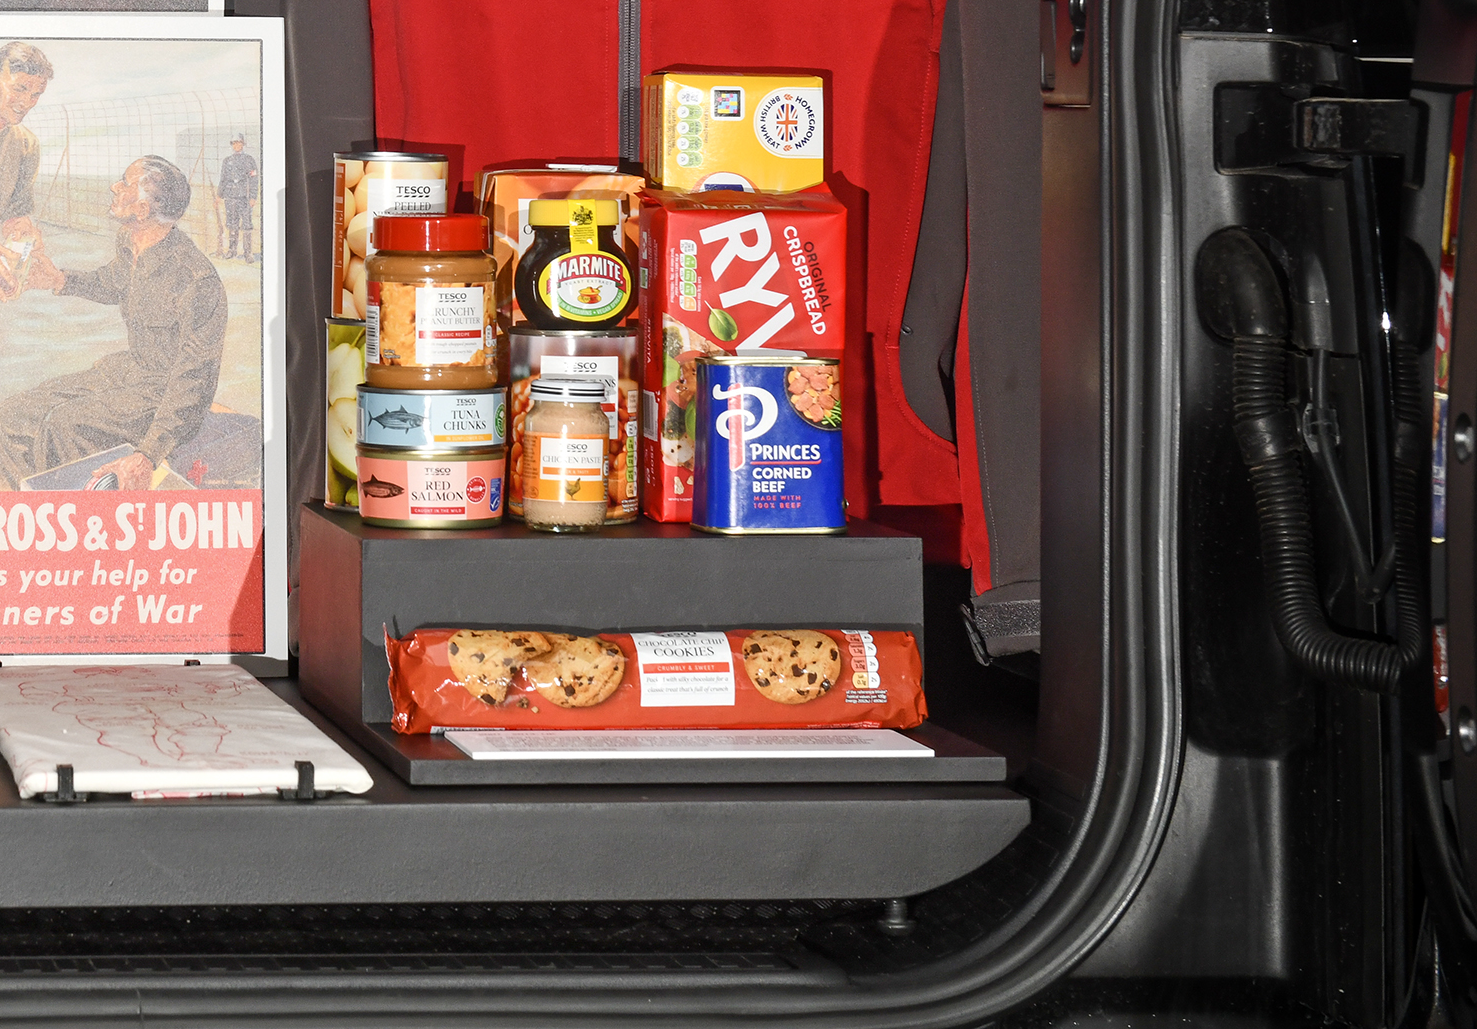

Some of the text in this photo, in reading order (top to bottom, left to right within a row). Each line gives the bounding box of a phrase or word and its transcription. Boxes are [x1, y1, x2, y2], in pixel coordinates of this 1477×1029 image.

[760, 95, 780, 149] BRITISH WHEAT
[795, 95, 816, 150] HOMEGROWN
[396, 186, 431, 194] TESCO
[394, 202, 431, 211] PEELED
[557, 256, 622, 281] MARMITE
[783, 225, 827, 335] CRISPBREAD
[804, 241, 832, 312] ORIGINAL
[433, 307, 476, 316] RUNCHY
[451, 410, 480, 420] TUNA
[443, 421, 486, 431] CHUNKS
[750, 443, 821, 461] PRINCES
[752, 467, 812, 480] CORNED
[425, 481, 450, 490] RED
[752, 481, 786, 493] BEEF
[411, 491, 464, 502] SALMON
[83, 515, 109, 550] &
[148, 502, 254, 550] JOHN
[20, 569, 83, 593] your
[91, 559, 149, 591] help
[159, 559, 197, 584] for
[89, 595, 124, 626] of
[136, 594, 202, 625] War
[638, 638, 699, 647] CHOCOLATE
[653, 646, 715, 657] COOKIES
